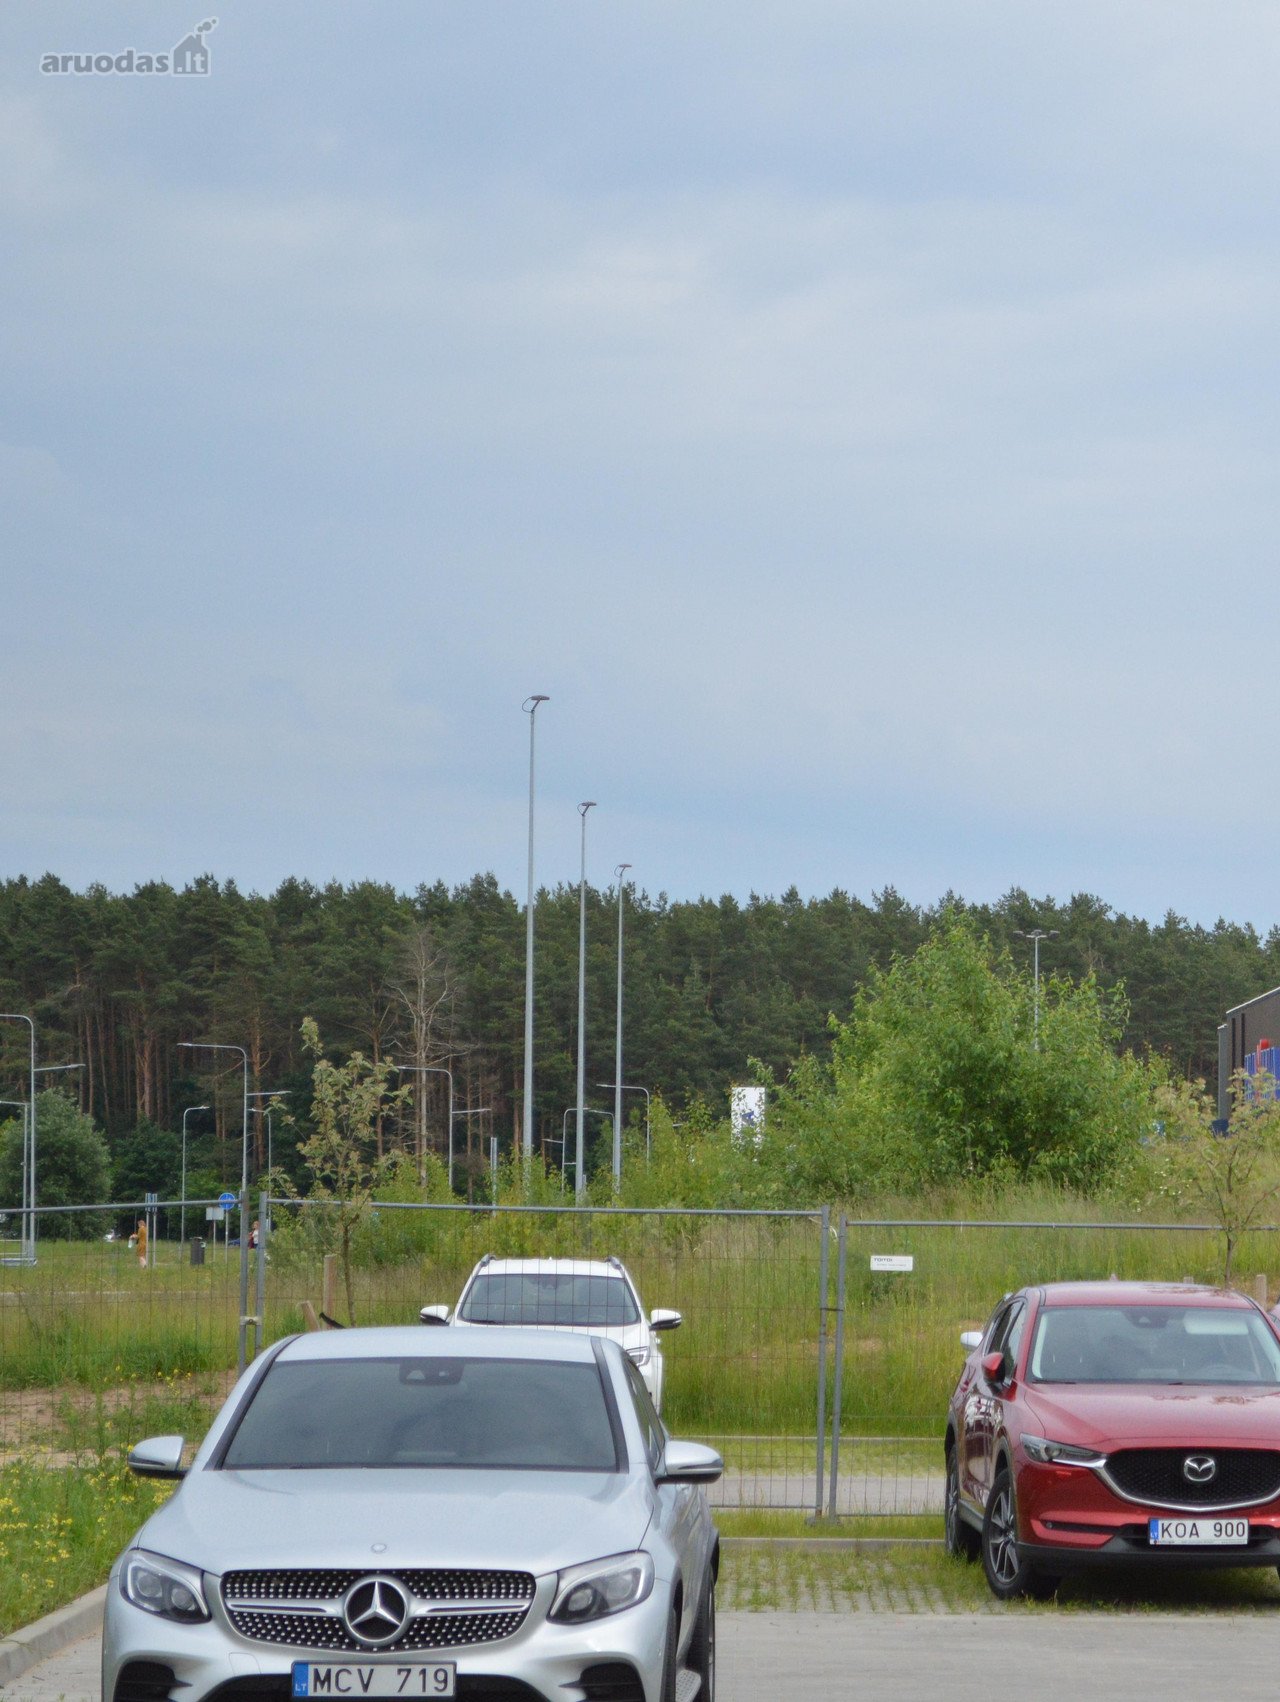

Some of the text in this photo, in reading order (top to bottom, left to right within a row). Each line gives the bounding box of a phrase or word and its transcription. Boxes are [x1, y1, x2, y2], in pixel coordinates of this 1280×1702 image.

[1161, 1521, 1246, 1538] KOA 900
[295, 1683, 307, 1692] LT
[312, 1667, 449, 1693] MCV 719
